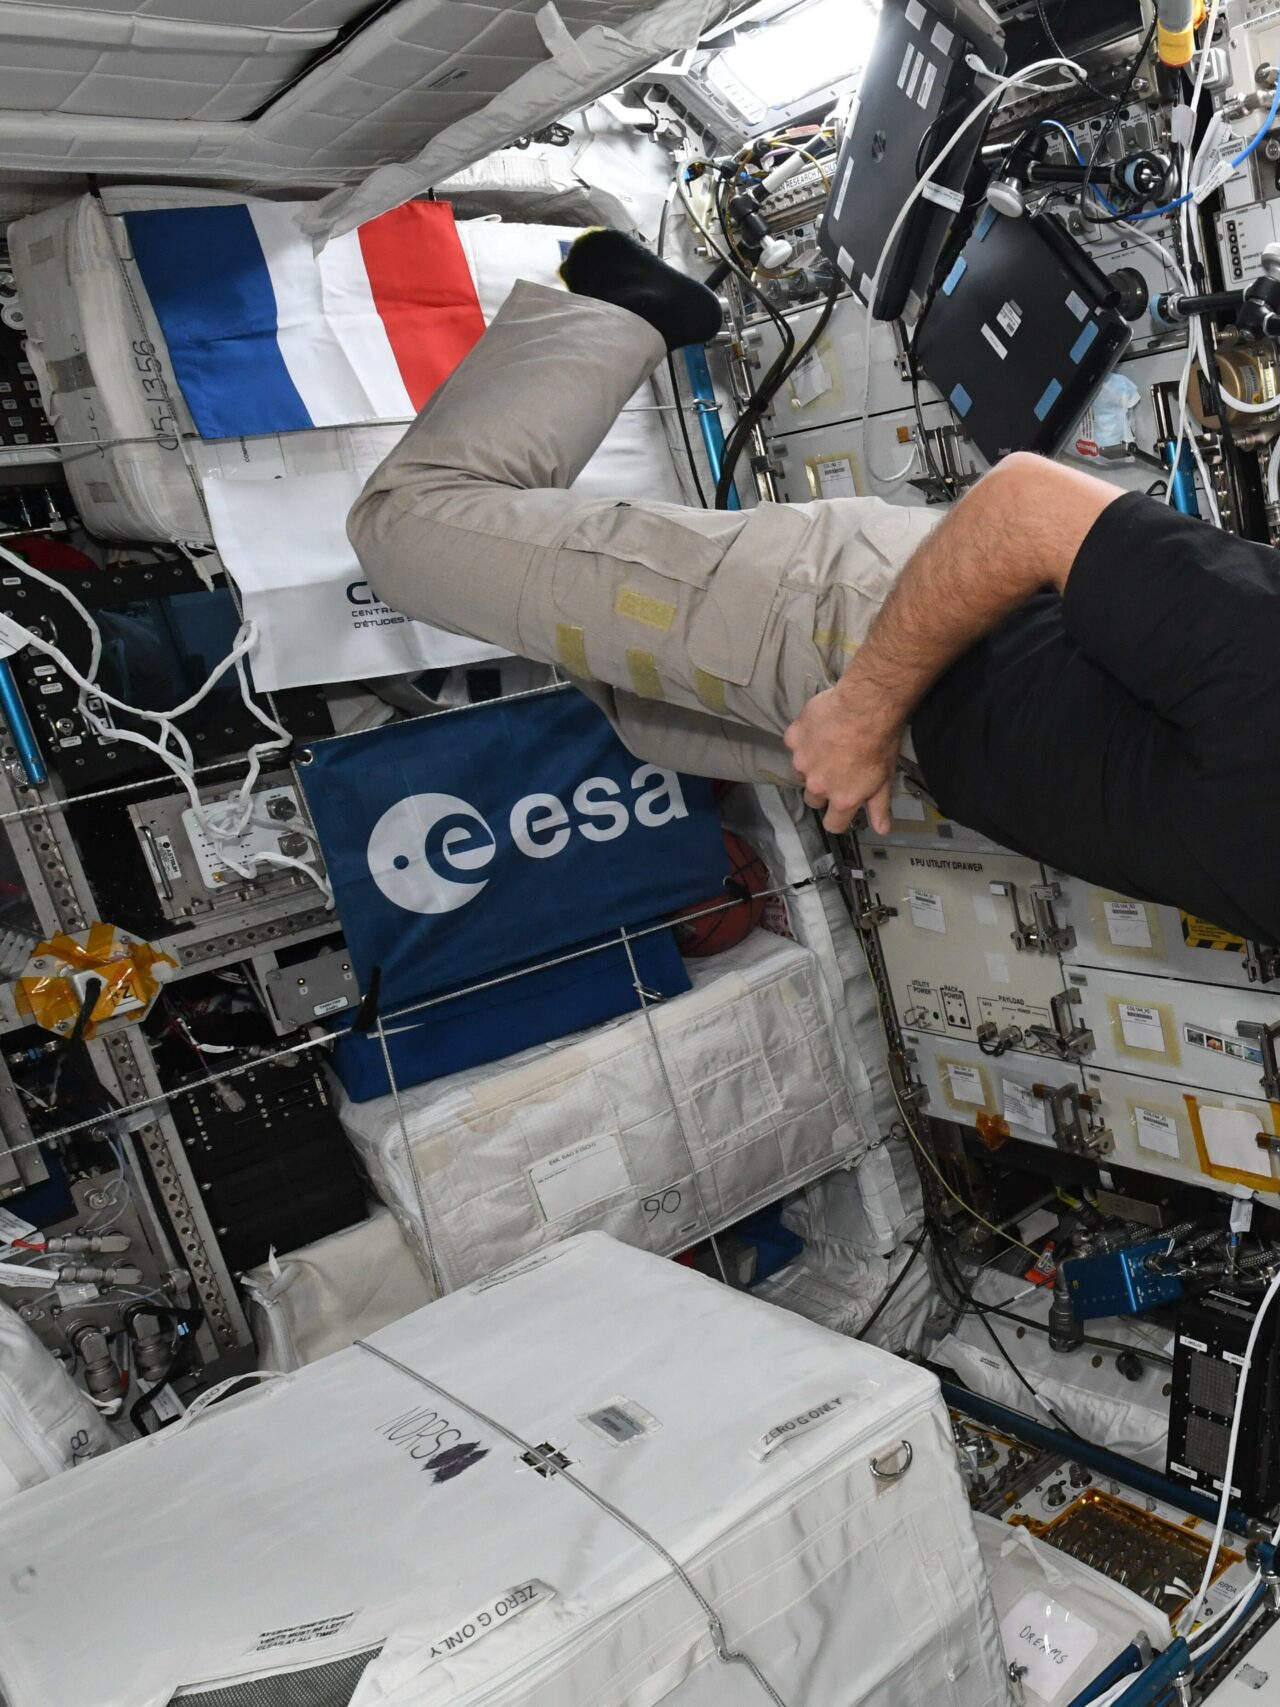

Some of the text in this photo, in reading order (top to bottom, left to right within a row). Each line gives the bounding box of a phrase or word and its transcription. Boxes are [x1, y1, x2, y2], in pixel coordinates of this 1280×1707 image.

[354, 616, 405, 629] D'ÉTUDES
[509, 763, 690, 859] esa
[926, 860, 950, 870] UTILITY
[952, 861, 984, 873] DRAWER
[912, 980, 930, 988] UTILITY
[913, 986, 932, 996] POWER
[943, 992, 962, 1000] POWER
[998, 995, 1025, 1006] PAYLOAD
[644, 1190, 681, 1223] 90
[761, 1397, 842, 1446] ZERO G ONLY
[375, 1406, 461, 1460] NORS
[430, 1585, 538, 1658] ZERO G ONLY
